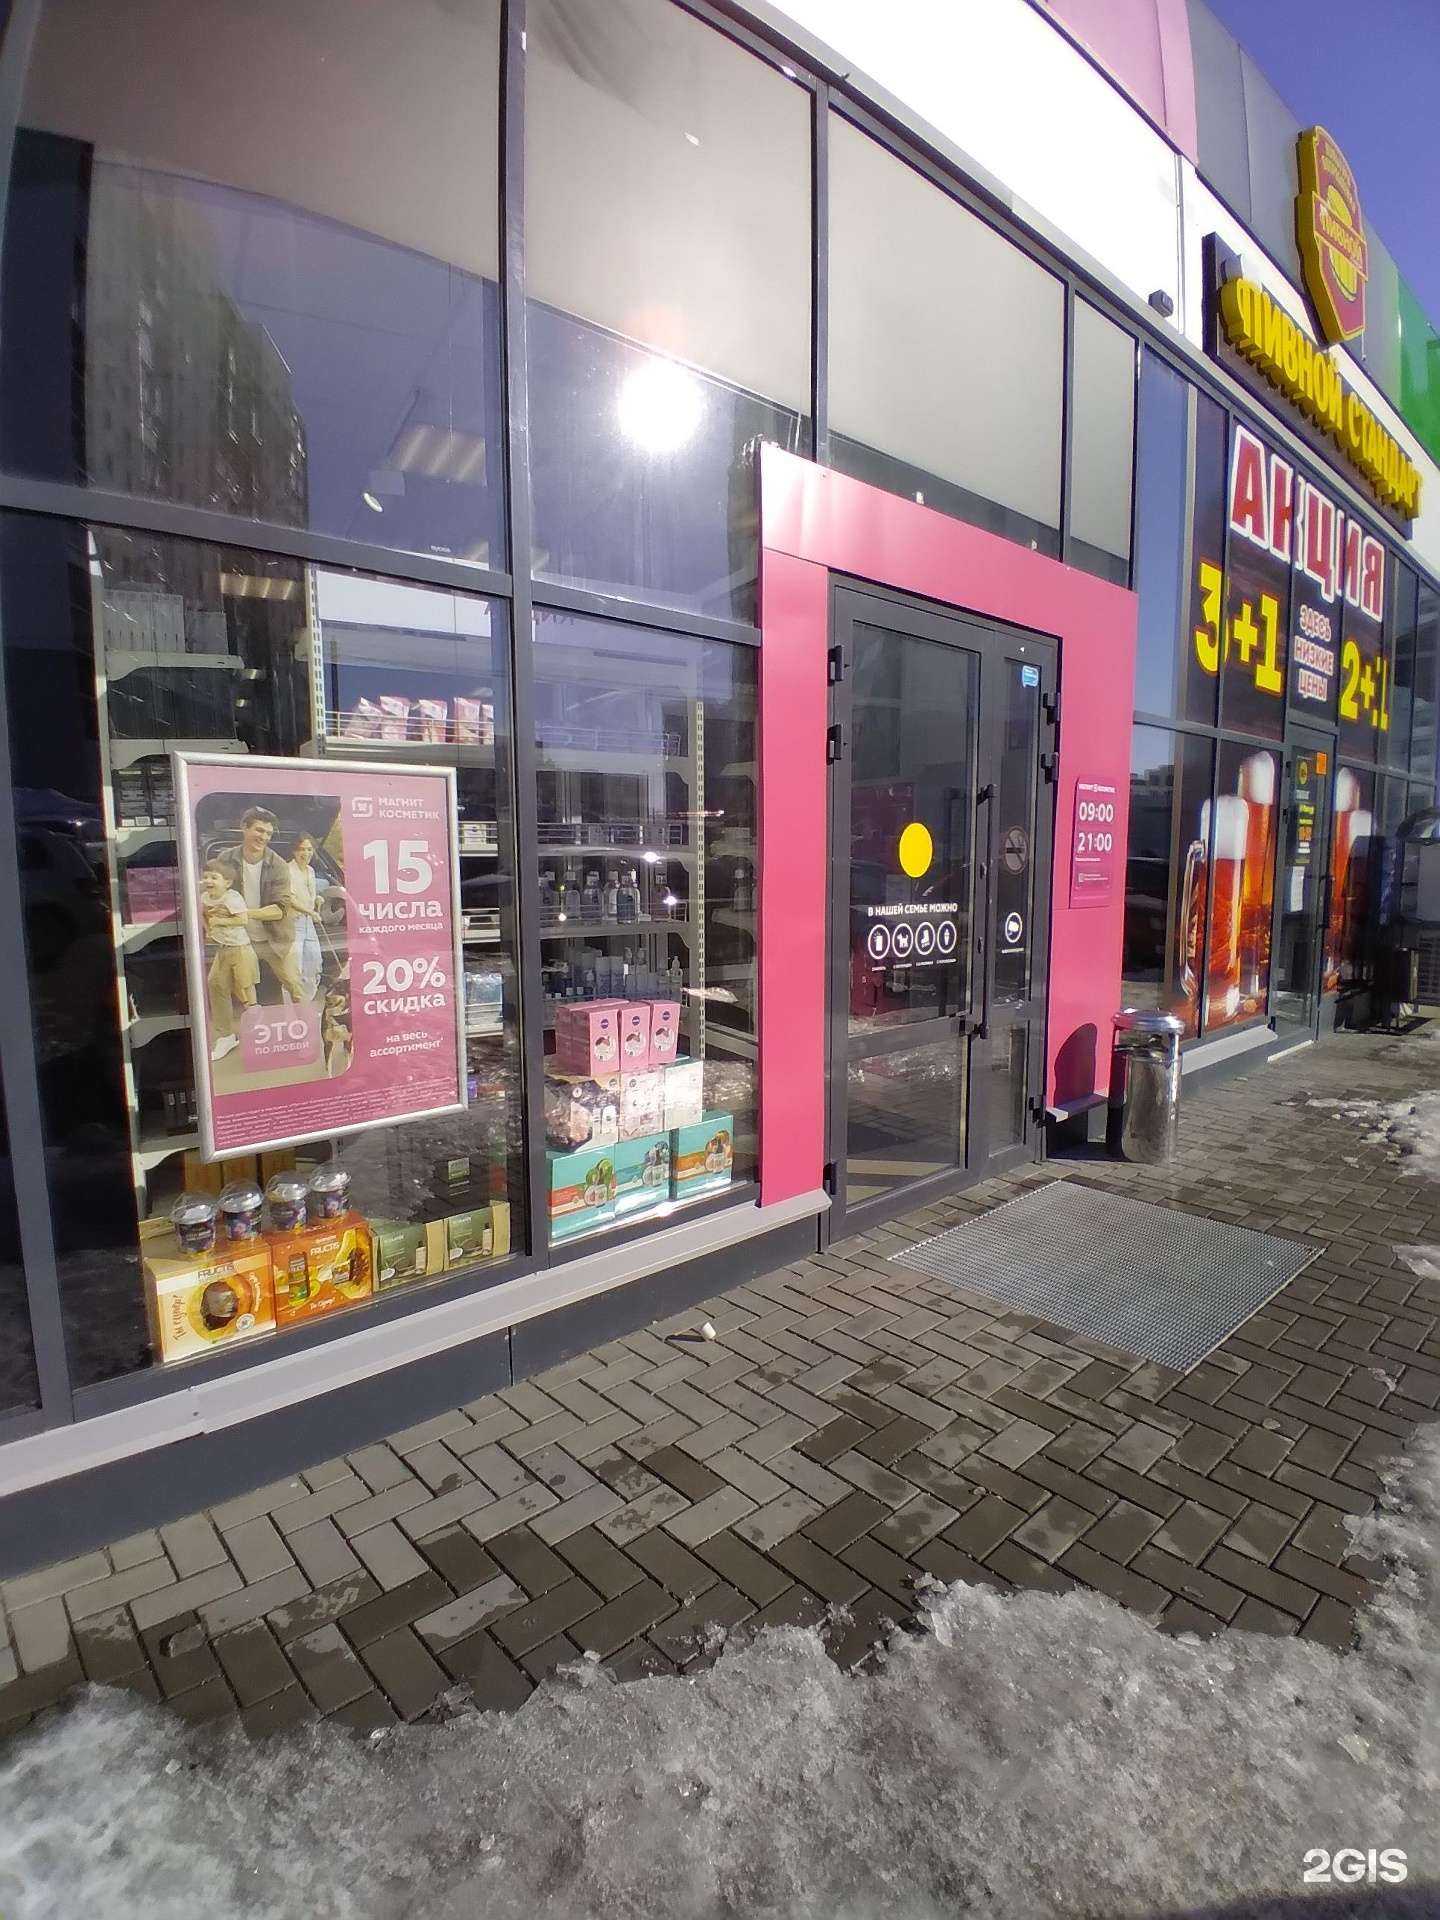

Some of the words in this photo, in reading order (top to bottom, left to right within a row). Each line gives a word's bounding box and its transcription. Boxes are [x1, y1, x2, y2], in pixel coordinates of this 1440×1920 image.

[1221, 277, 1343, 432] ПИВНОЙ
[1230, 425, 1385, 623] АКЦИЯ
[1195, 561, 1283, 695] 3+1
[1299, 604, 1332, 642] ЗДЕСЬ
[1294, 635, 1335, 676] НИЗКИЕ
[1298, 668, 1328, 701] ЦЕНЫ
[1340, 641, 1389, 732] 2+1
[379, 798, 424, 807] МАГНИТ
[1079, 802, 1114, 822] 09:00
[379, 810, 440, 819] КОСМЕТИК
[1078, 832, 1112, 852] 21:00
[363, 840, 433, 894] 15
[359, 900, 443, 920] числа
[867, 906, 874, 916] В
[876, 902, 904, 916] НАШЕЙ
[905, 903, 929, 914] СЕМЬЕ
[929, 902, 958, 913] МОЖНО
[359, 924, 406, 934] каждого
[408, 922, 443, 931] месяца
[362, 956, 446, 995] 20%
[363, 993, 446, 1015] скидка
[254, 1020, 308, 1044] ЭТО
[386, 1034, 400, 1043] на
[402, 1031, 428, 1040] весь
[255, 1046, 270, 1055] ПО
[273, 1041, 309, 1053] ЛЮБВИ
